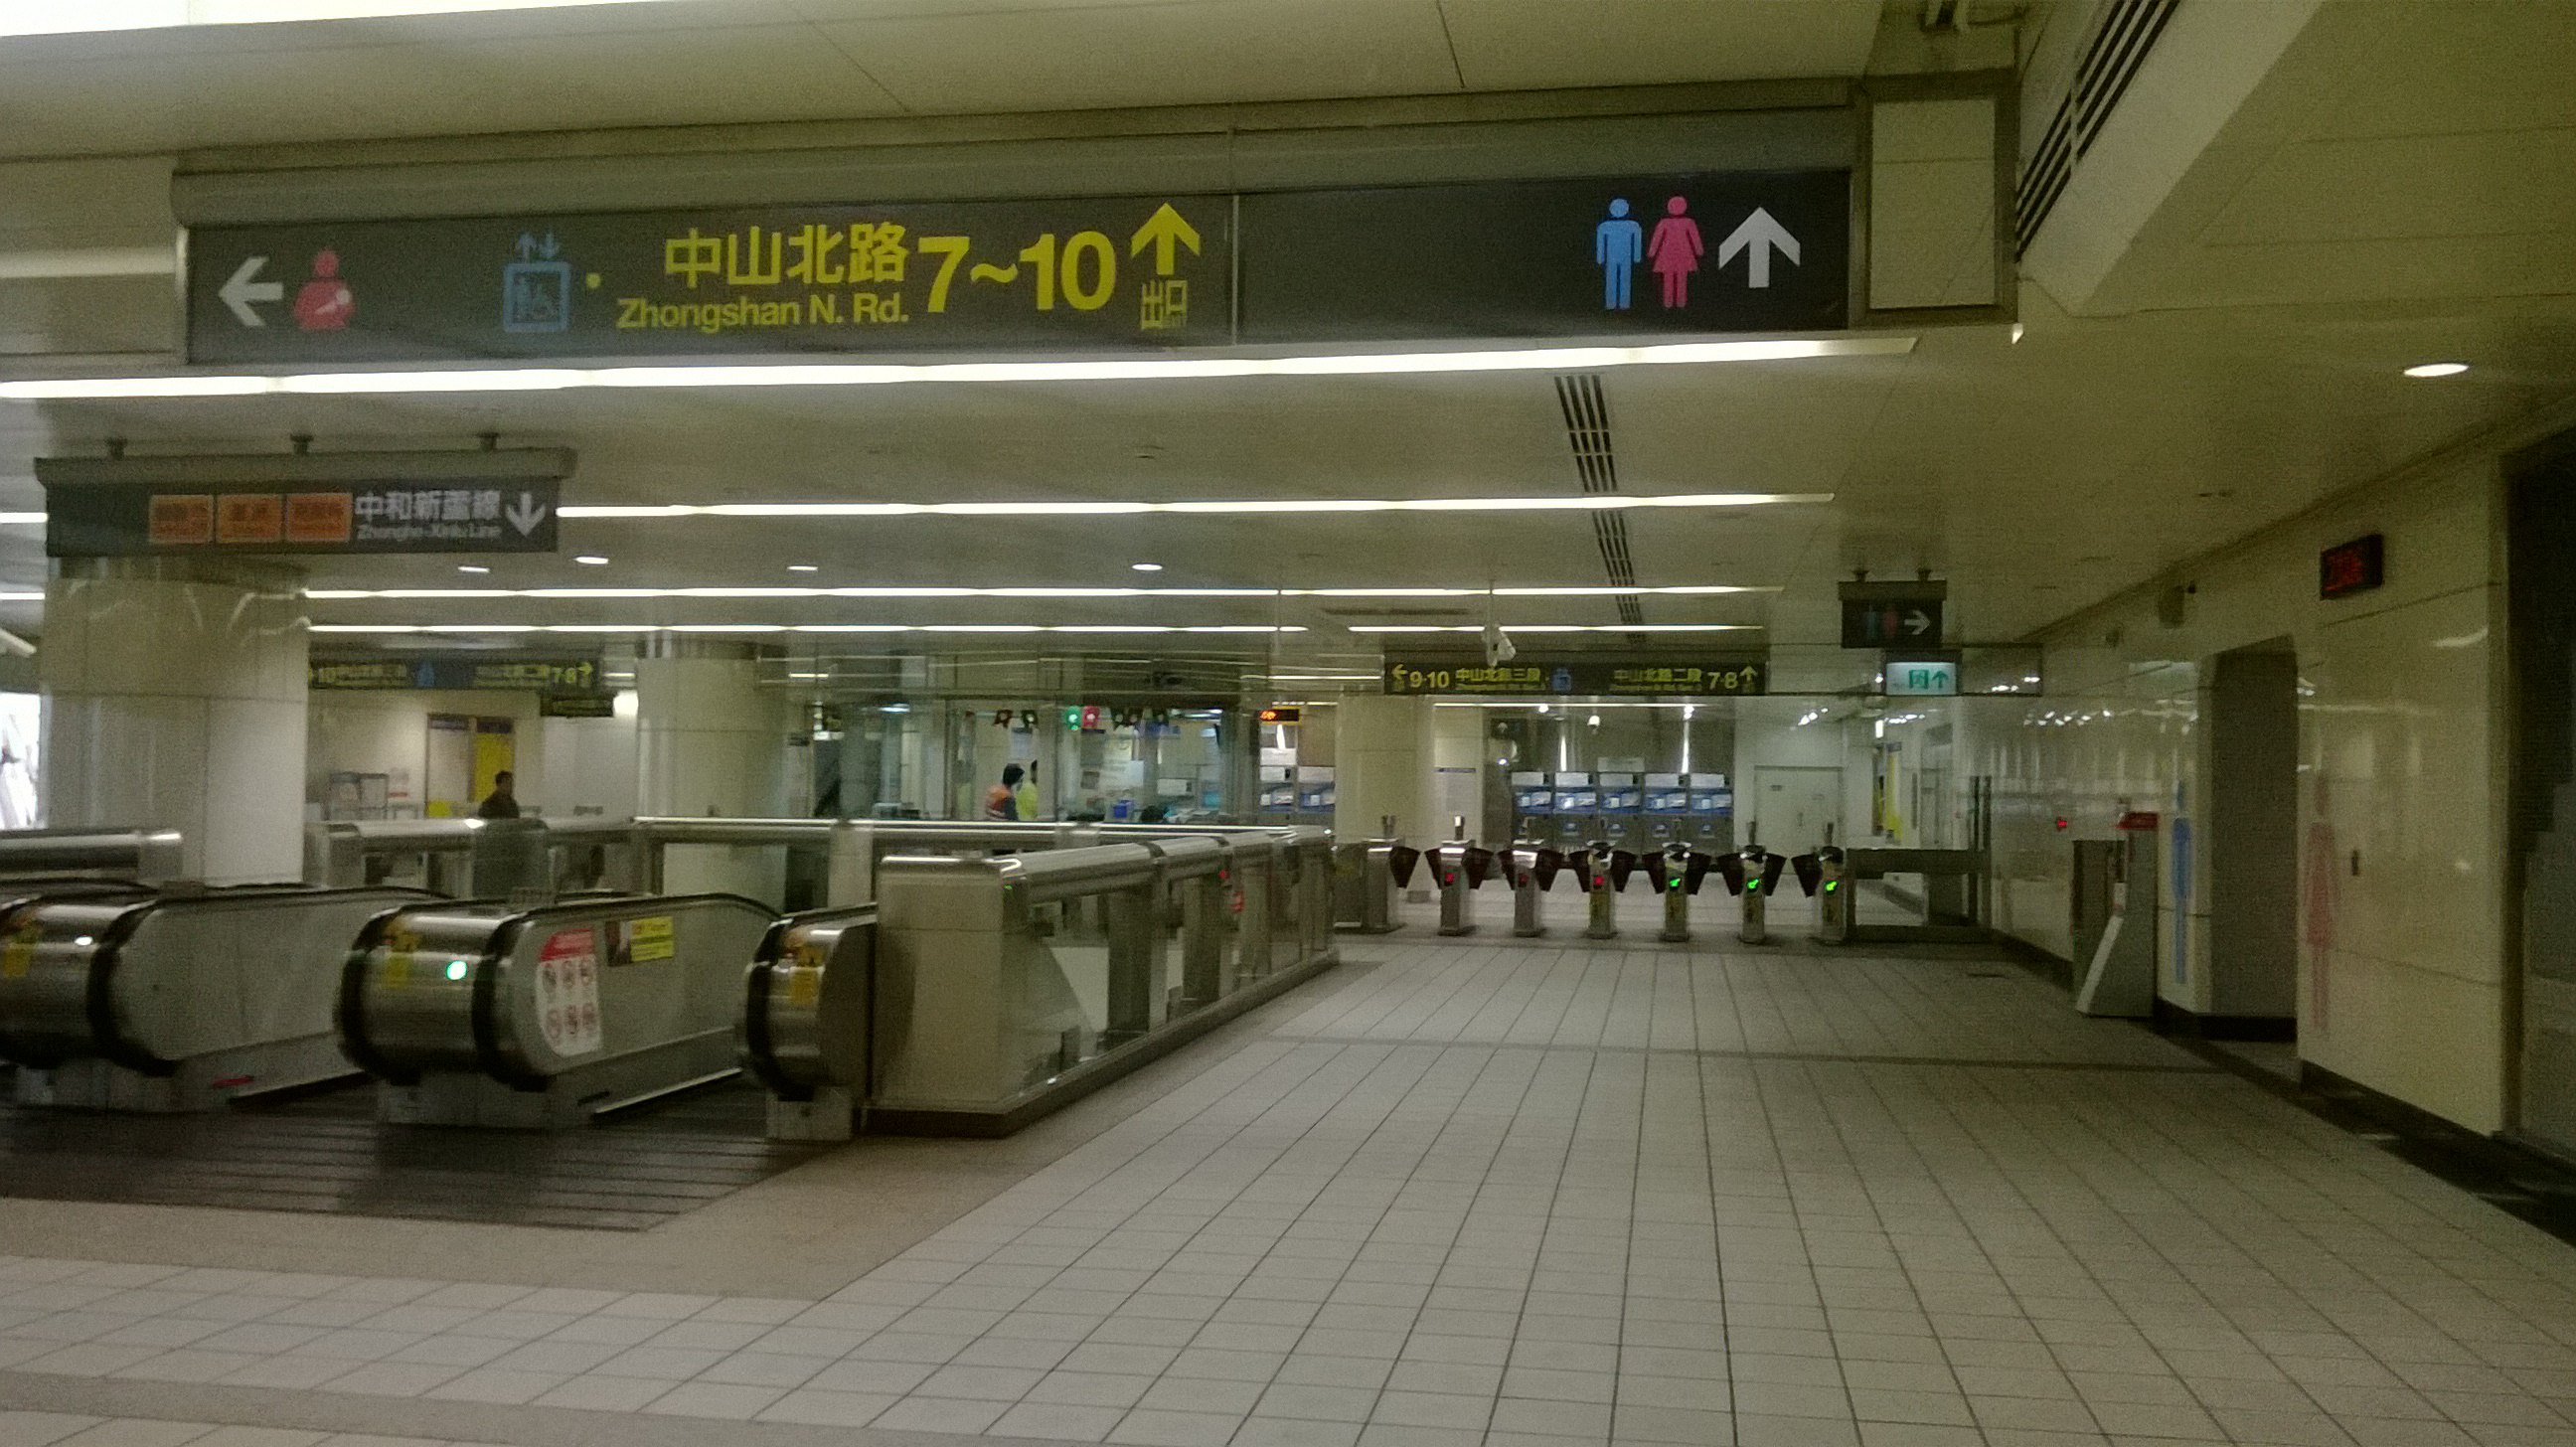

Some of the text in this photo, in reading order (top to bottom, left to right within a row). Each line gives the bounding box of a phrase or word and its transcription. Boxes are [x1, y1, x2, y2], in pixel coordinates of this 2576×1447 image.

[665, 222, 908, 288] 中山北路
[918, 231, 1116, 311] 7~10
[616, 292, 909, 333] Zhongshan N. Rd.
